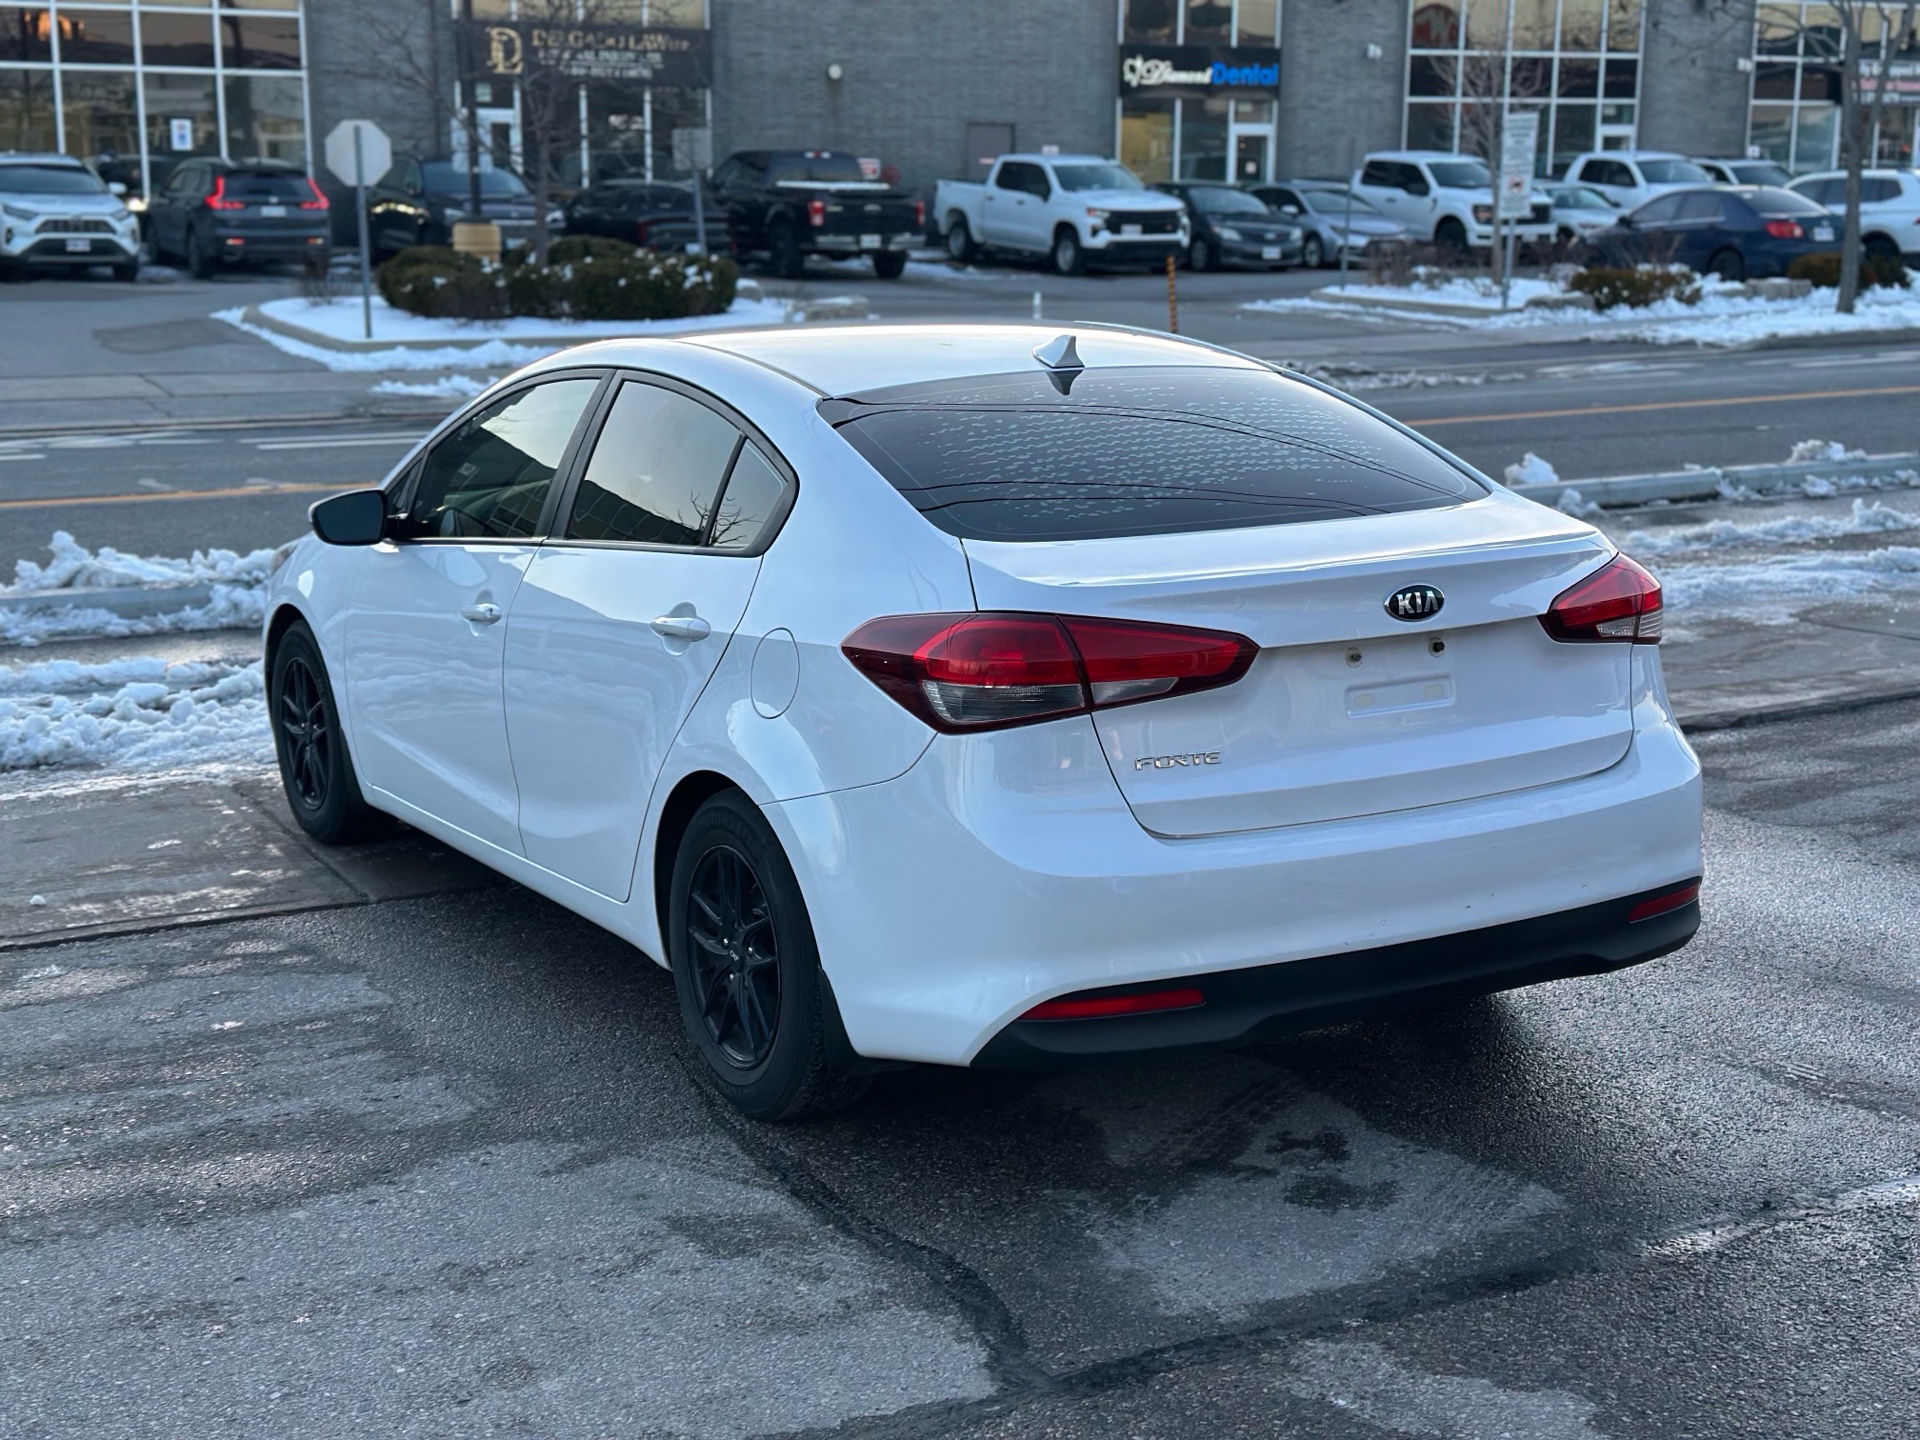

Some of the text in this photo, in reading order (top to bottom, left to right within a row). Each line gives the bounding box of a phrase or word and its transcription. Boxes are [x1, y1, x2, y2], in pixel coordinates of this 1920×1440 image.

[1139, 58, 1280, 86] Diamond Dental
[1396, 590, 1439, 615] KIA
[1134, 751, 1222, 771] FORTE
